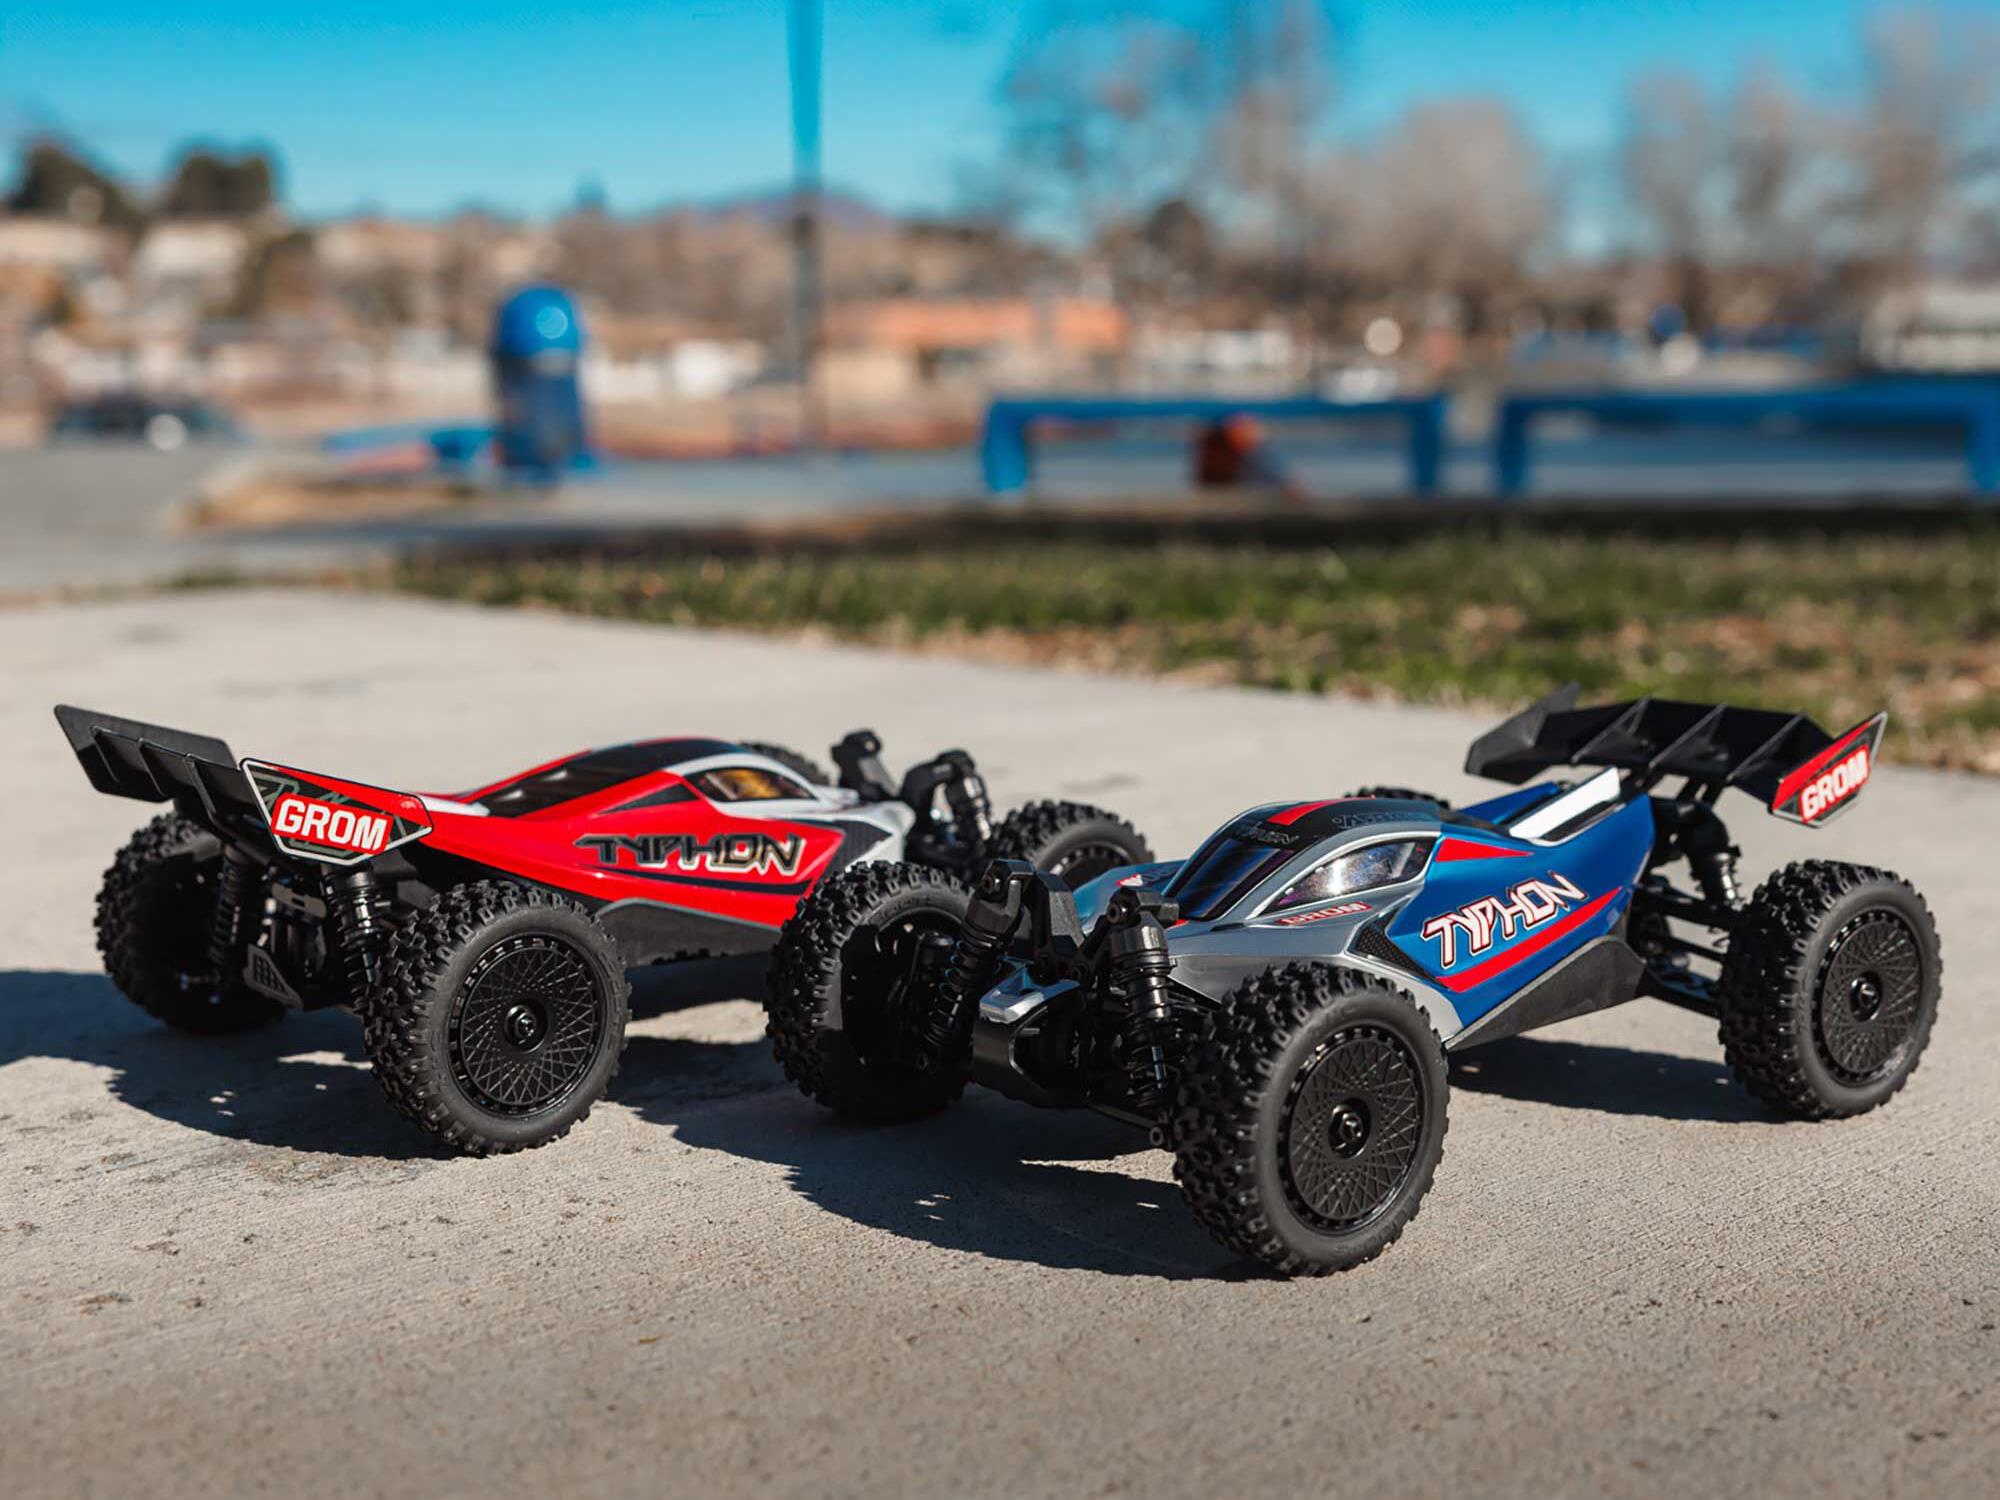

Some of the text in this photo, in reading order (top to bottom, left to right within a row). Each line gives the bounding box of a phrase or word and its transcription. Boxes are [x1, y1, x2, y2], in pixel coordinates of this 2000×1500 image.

[1801, 750, 1868, 820] GROM
[275, 798, 388, 851] GROM
[574, 833, 806, 876] TYPHON
[1421, 870, 1587, 968] TYPHON
